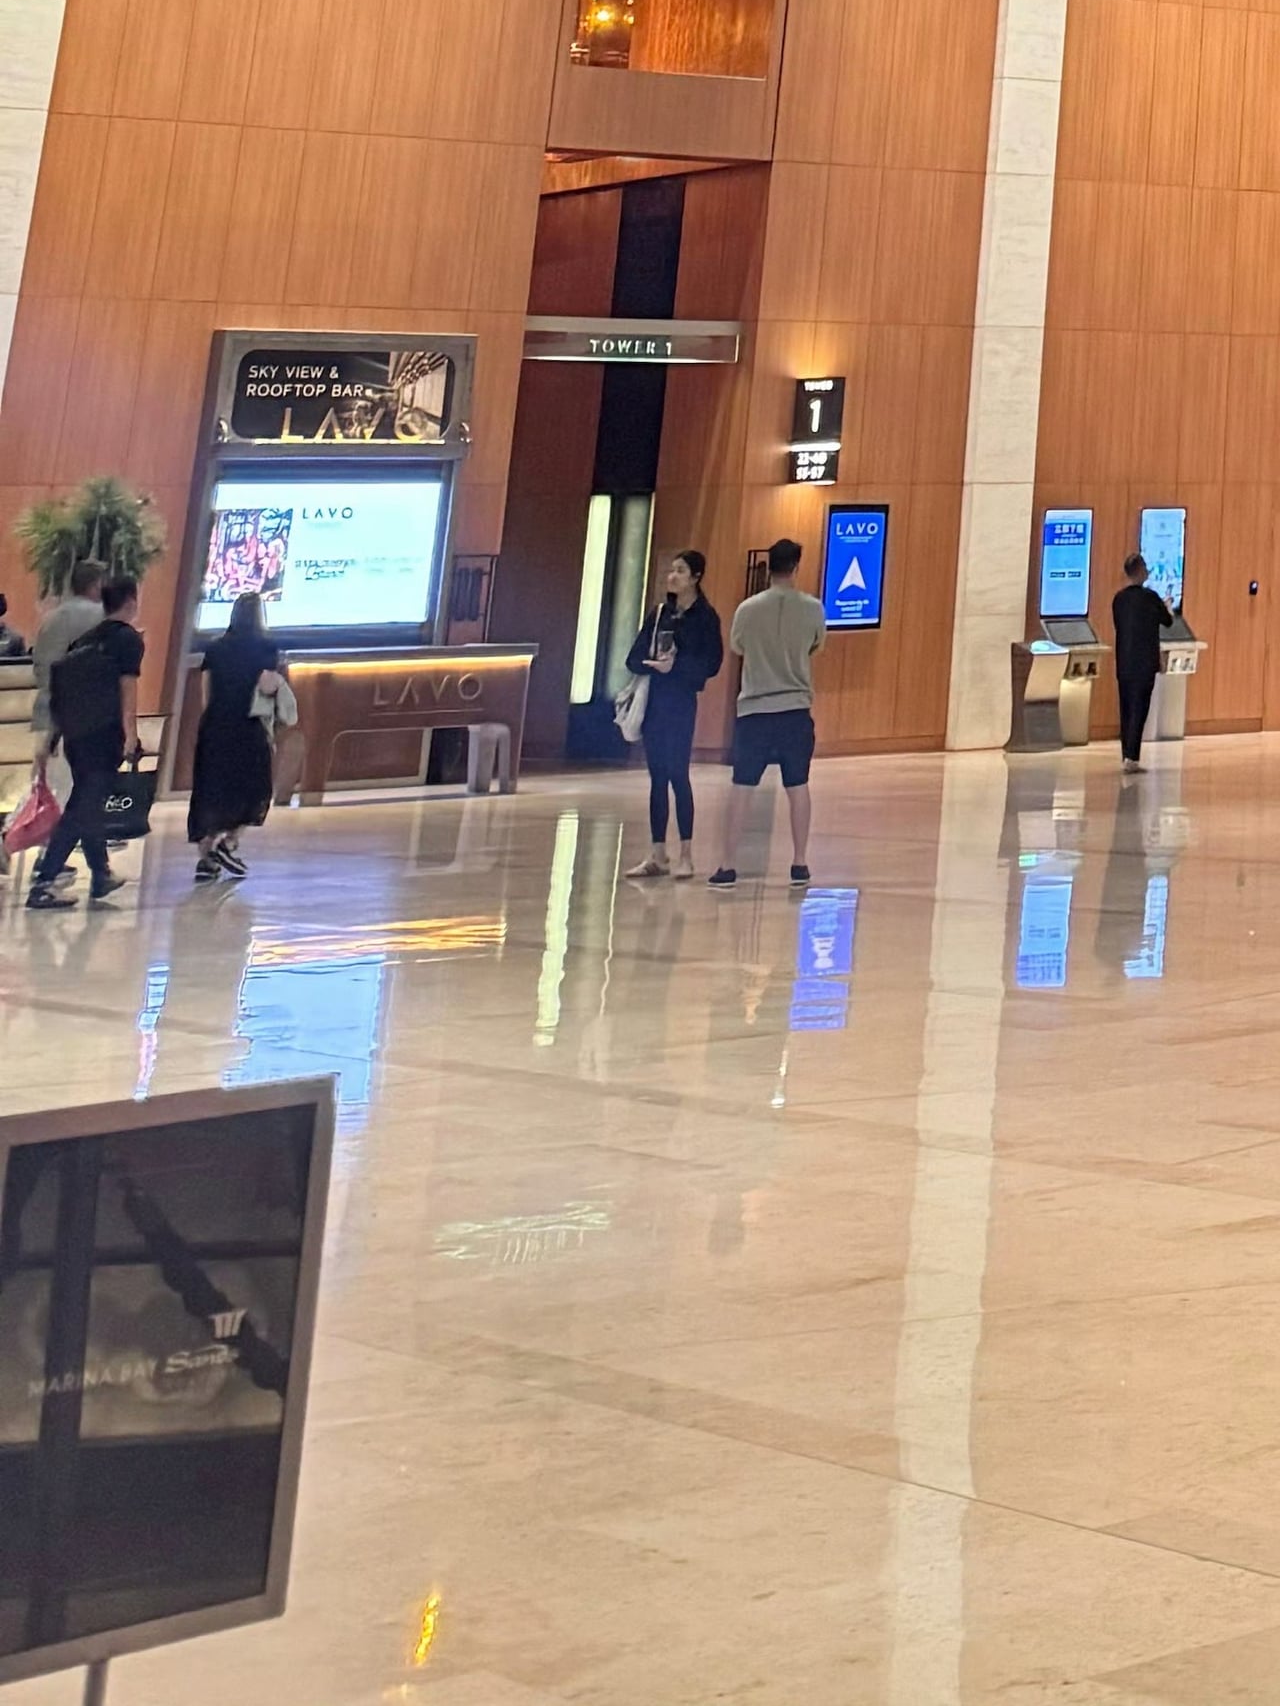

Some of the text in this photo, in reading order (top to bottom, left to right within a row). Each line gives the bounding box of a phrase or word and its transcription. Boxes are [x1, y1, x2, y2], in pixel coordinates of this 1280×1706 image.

[589, 338, 673, 357] TOWER 1
[248, 365, 340, 379] SKY VIEW &
[245, 383, 364, 398] ROOFTOP BAR
[281, 406, 428, 443] LAVO
[809, 398, 822, 433] 1
[302, 506, 354, 520] LAVO
[835, 522, 879, 536] LAVO
[373, 672, 483, 706] LAVO
[26, 1366, 114, 1398] MARINA
[120, 1354, 159, 1384] BAY
